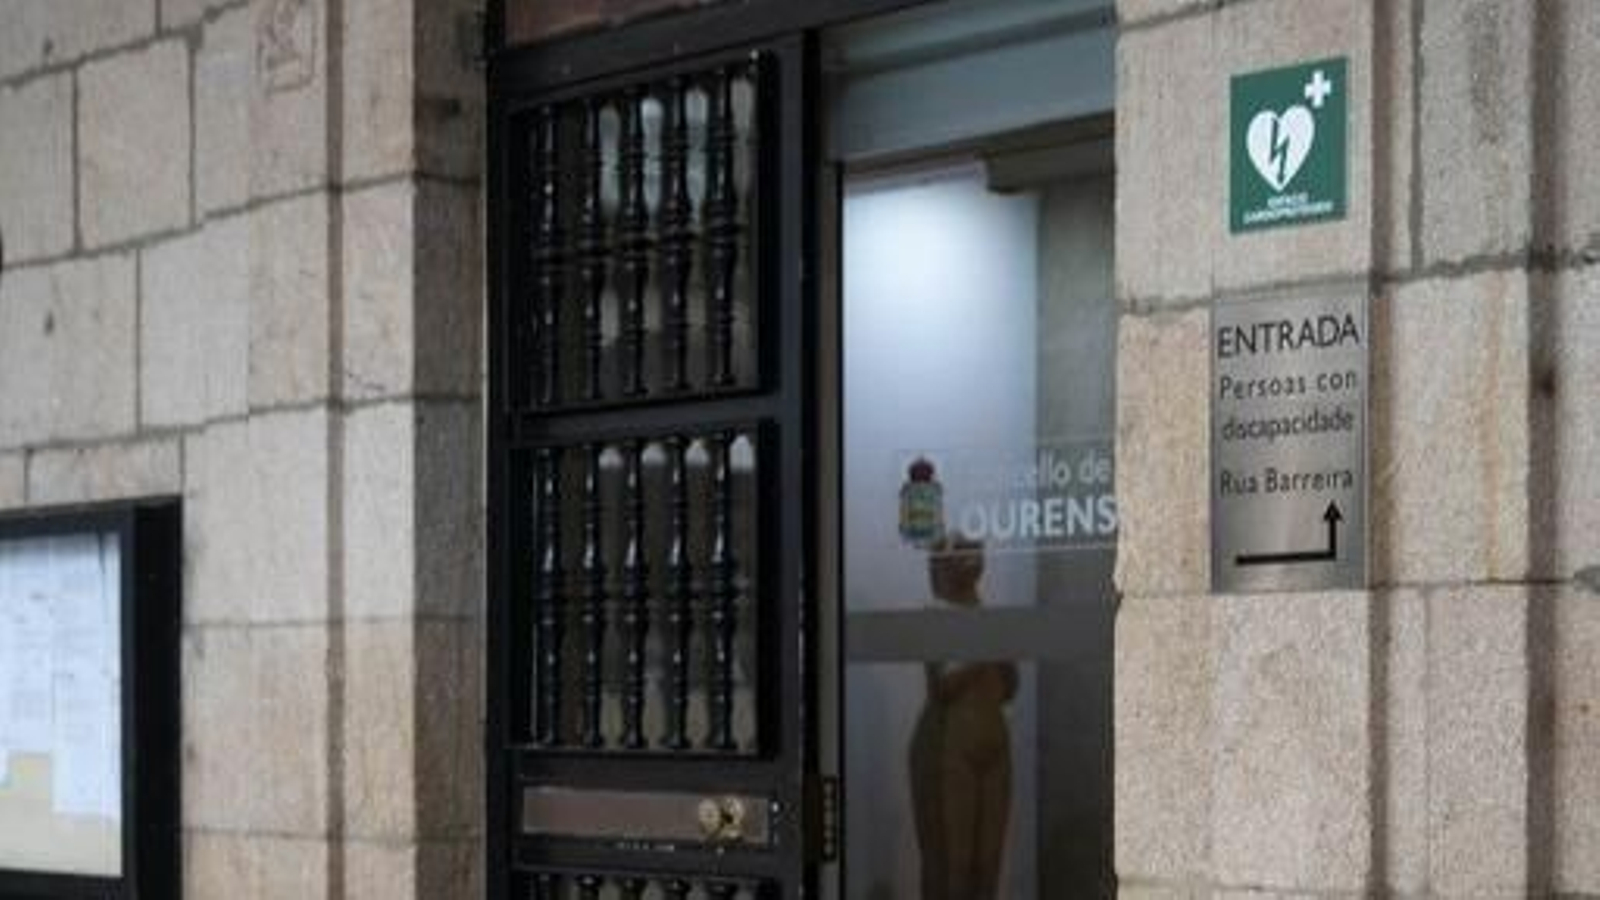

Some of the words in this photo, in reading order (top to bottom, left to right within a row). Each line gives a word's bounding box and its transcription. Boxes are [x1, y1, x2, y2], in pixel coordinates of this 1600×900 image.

[1217, 314, 1360, 358] ENTRADA
[1220, 374, 1306, 400] Persoas
[1316, 370, 1358, 392] con
[1079, 449, 1111, 484] de
[1265, 467, 1353, 493] Barreira
